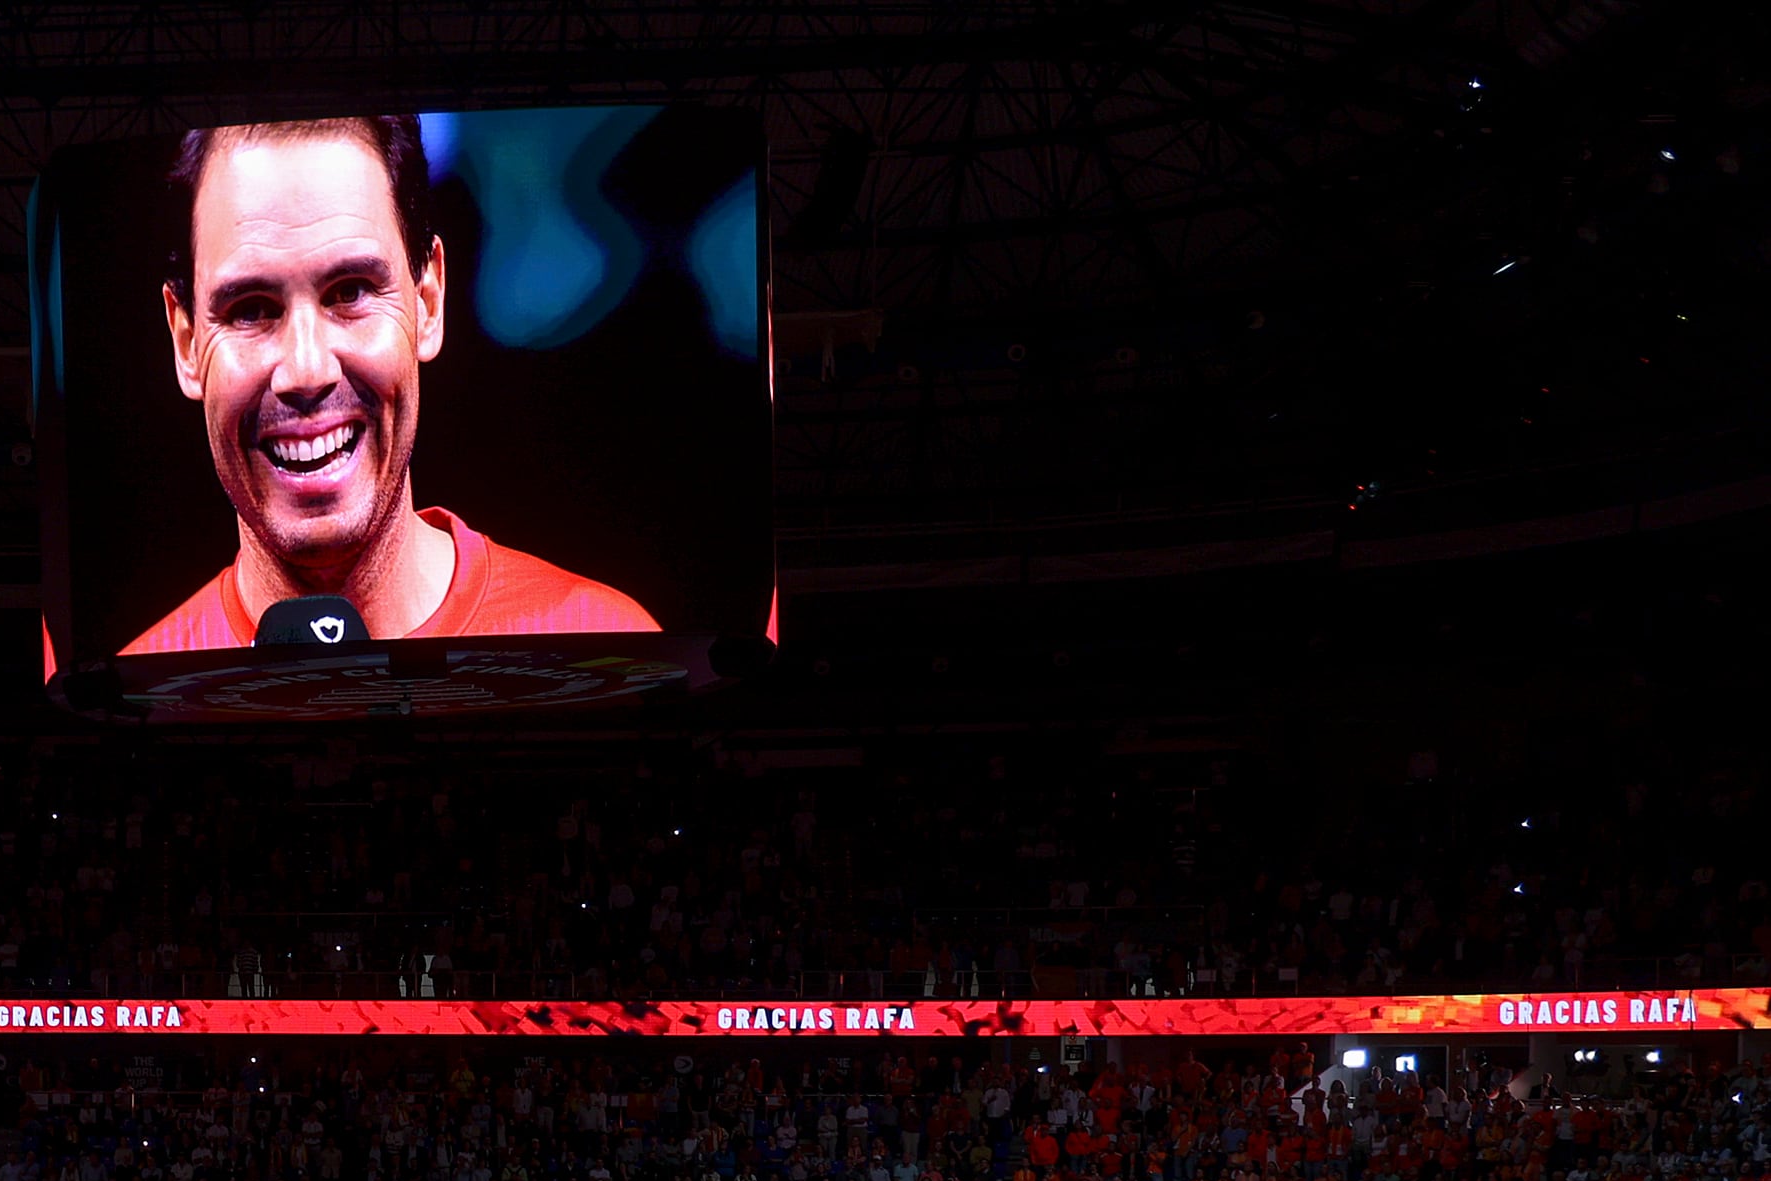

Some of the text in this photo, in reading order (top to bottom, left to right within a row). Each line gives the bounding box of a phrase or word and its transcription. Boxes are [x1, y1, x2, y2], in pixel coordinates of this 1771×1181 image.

[116, 1006, 181, 1027] RAFA
[717, 1008, 915, 1029] GRACIAS RAFA
[1499, 998, 1696, 1025] GRACIAS RAFA
[133, 1056, 155, 1066] THE
[125, 1067, 164, 1077] WORLD
